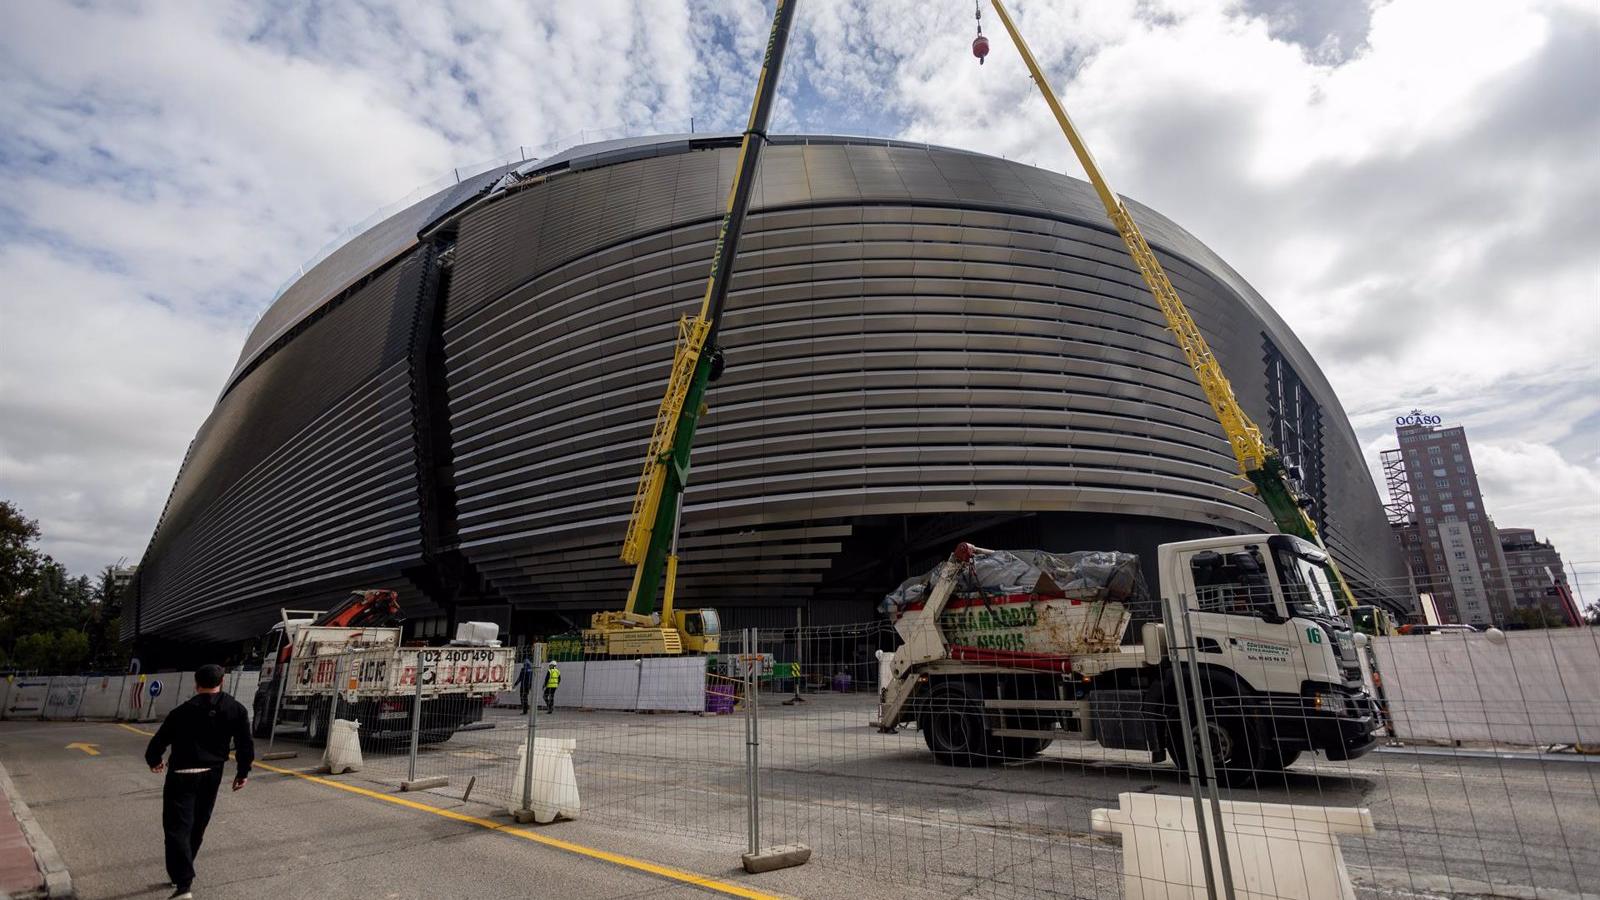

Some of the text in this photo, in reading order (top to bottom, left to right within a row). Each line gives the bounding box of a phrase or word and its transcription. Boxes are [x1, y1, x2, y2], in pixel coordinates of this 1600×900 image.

[1396, 415, 1441, 426] OCASO
[1305, 627, 1321, 644] 16
[445, 651, 469, 662] 400
[473, 651, 494, 662] 490
